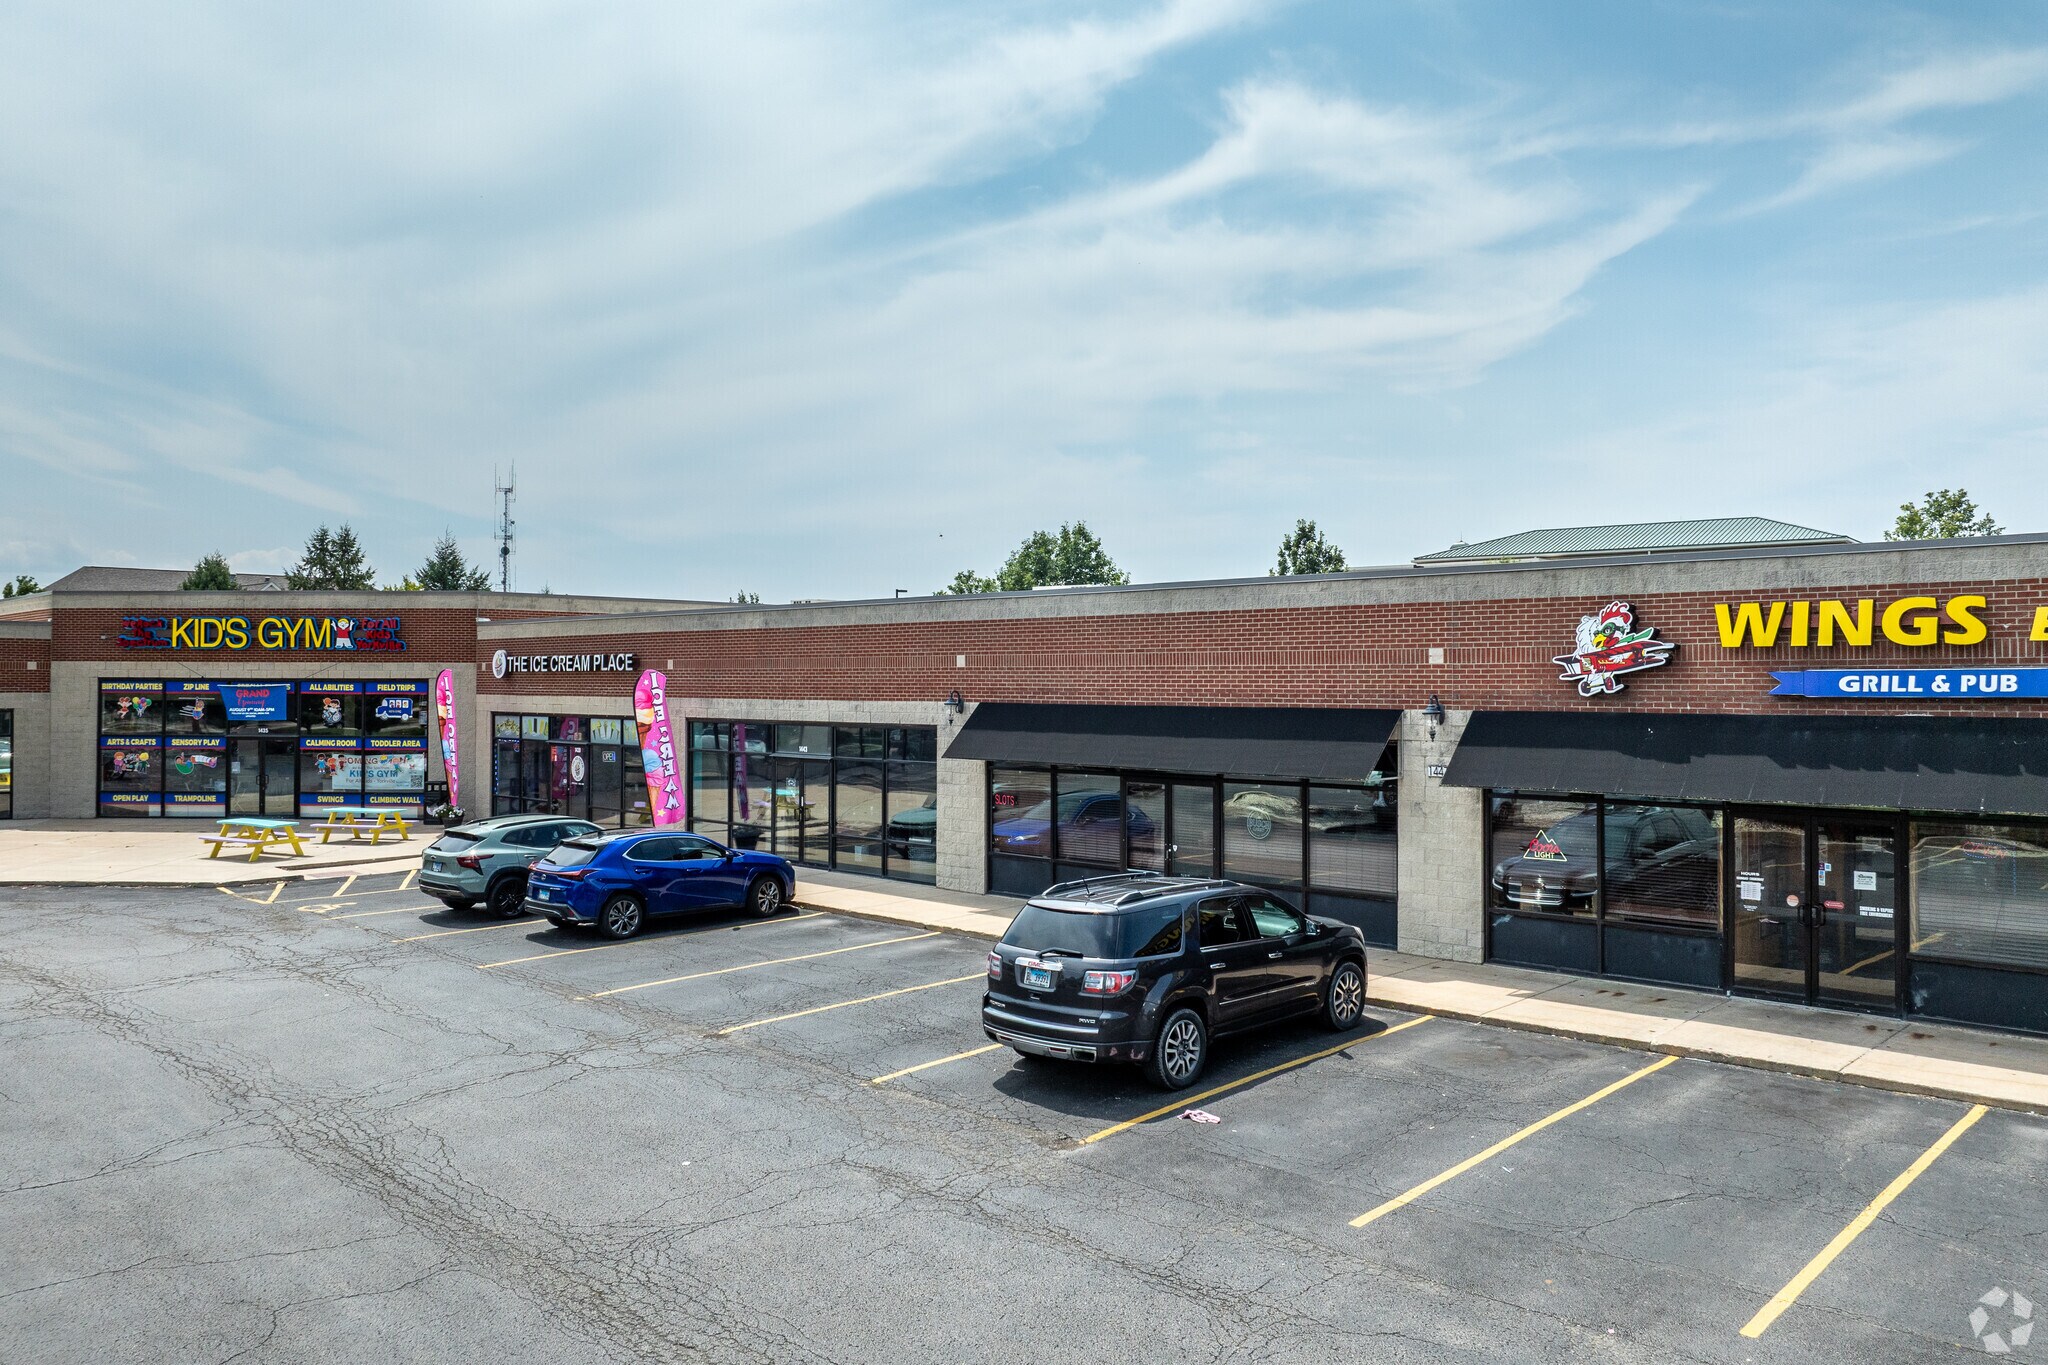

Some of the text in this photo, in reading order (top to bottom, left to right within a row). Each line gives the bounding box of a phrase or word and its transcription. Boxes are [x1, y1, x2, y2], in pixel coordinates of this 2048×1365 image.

[361, 618, 397, 629] For All
[1714, 595, 1988, 648] WINGS
[171, 617, 331, 649] KID'S GYM
[366, 629, 391, 639] Kids
[356, 639, 403, 650] Yorkville
[507, 653, 634, 672] THE ICE CREAM PLACE
[183, 683, 210, 691] ZIP LINE
[309, 683, 322, 691] ALL
[1838, 674, 2018, 693] GRILL & PUB
[236, 689, 270, 698] GRAND
[342, 757, 378, 765] OMNG
[349, 769, 398, 778] KI'S GYM
[1429, 766, 1447, 775] 144
[370, 796, 421, 804] CLIMBING WALL
[995, 793, 1015, 805] SLOTS
[1529, 838, 1560, 853] Coors
[1534, 851, 1555, 859] LIGHT
[1028, 960, 1045, 968] GMC
